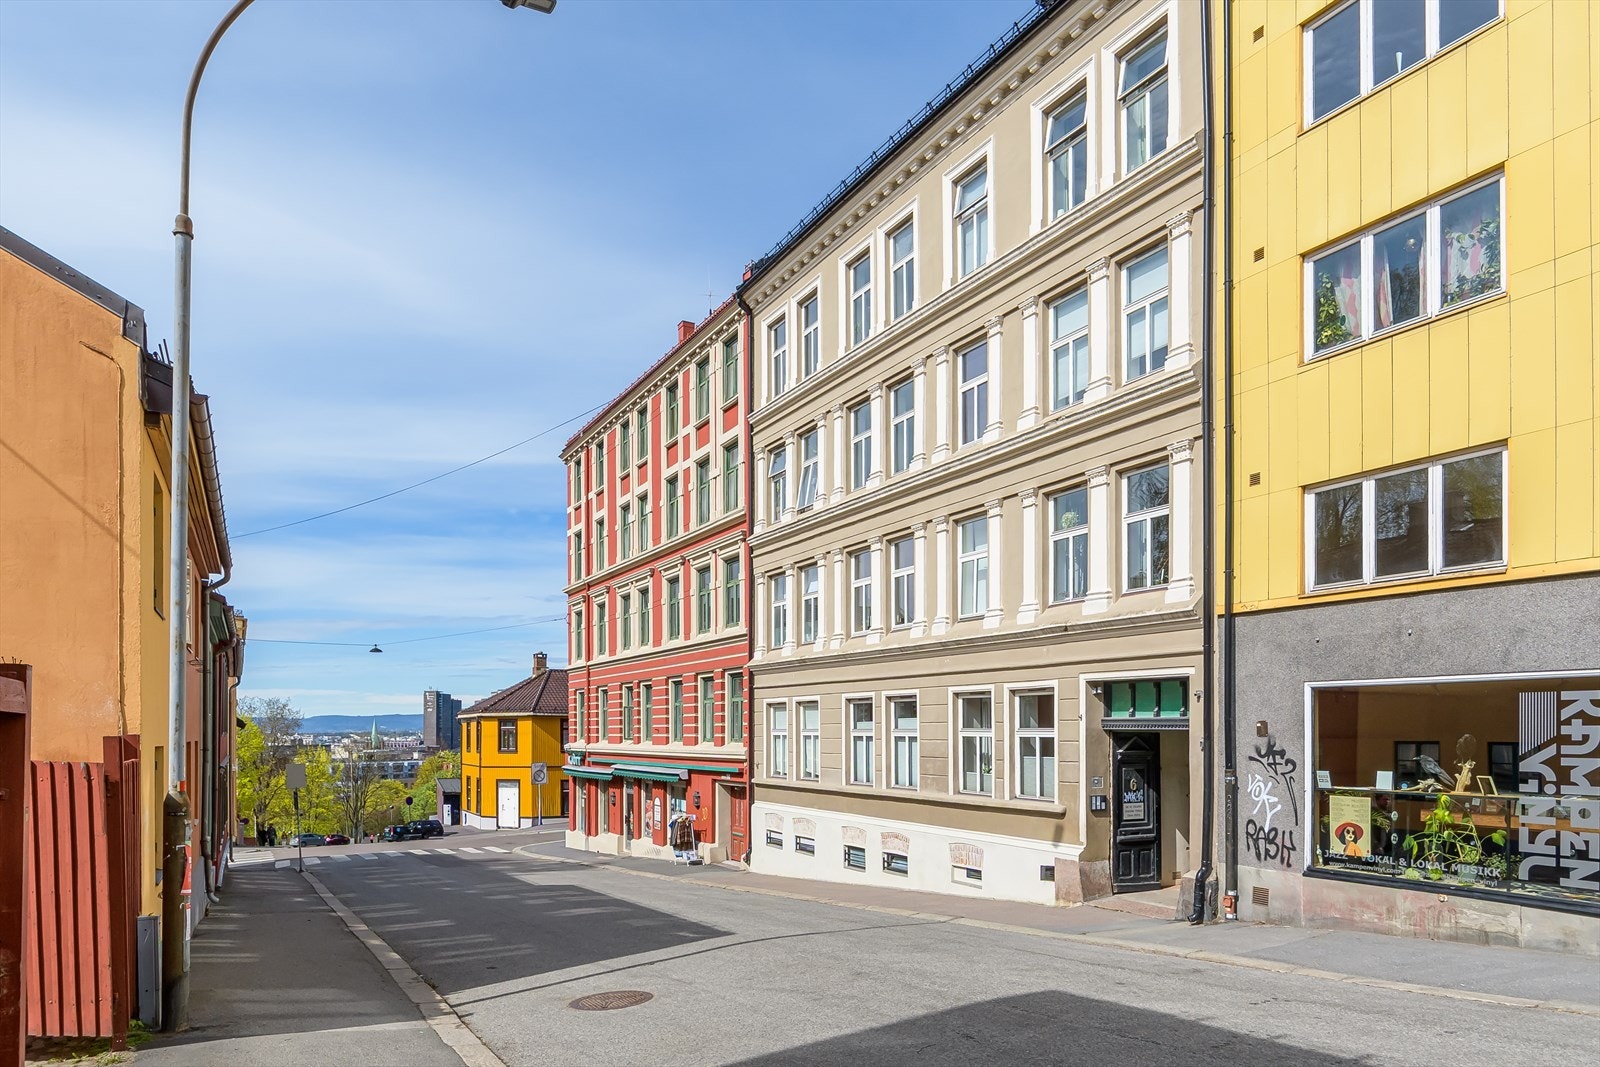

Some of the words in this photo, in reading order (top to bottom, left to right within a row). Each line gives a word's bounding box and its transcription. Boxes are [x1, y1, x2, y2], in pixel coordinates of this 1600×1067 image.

[1130, 778, 1137, 791] 6
[1560, 690, 1600, 890] KAMPEN
[1324, 849, 1349, 860] JAZZ
[1361, 854, 1396, 865] VOKAL
[1398, 857, 1408, 867] &
[1411, 858, 1448, 871] LOKAL
[1452, 863, 1501, 878] MUSIKK
